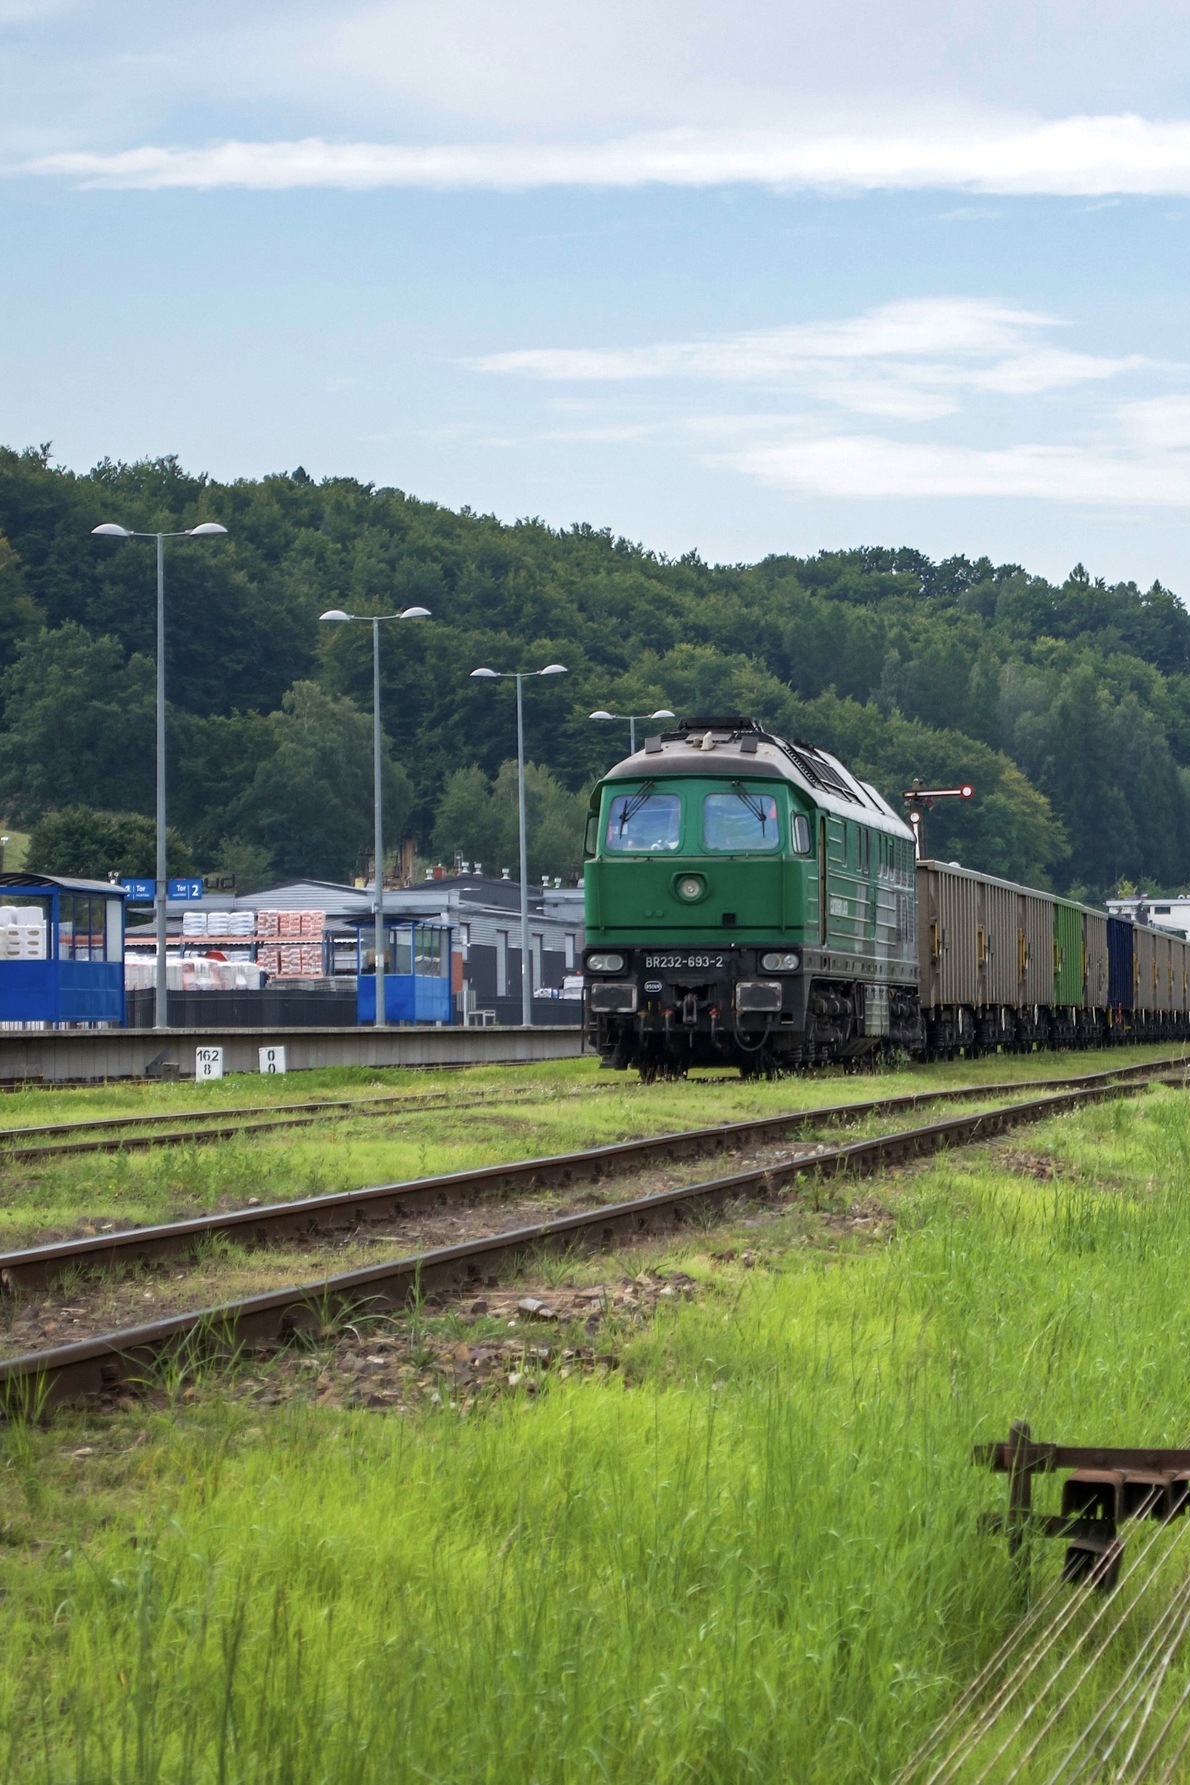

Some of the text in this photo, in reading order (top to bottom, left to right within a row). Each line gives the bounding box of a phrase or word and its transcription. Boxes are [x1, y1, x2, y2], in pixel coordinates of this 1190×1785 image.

[191, 884, 199, 896] 2
[646, 956, 723, 968] BR232-693-2
[197, 1050, 219, 1061] 162
[267, 1050, 275, 1061] 0
[204, 1064, 211, 1075] 8
[268, 1063, 276, 1074] 0
